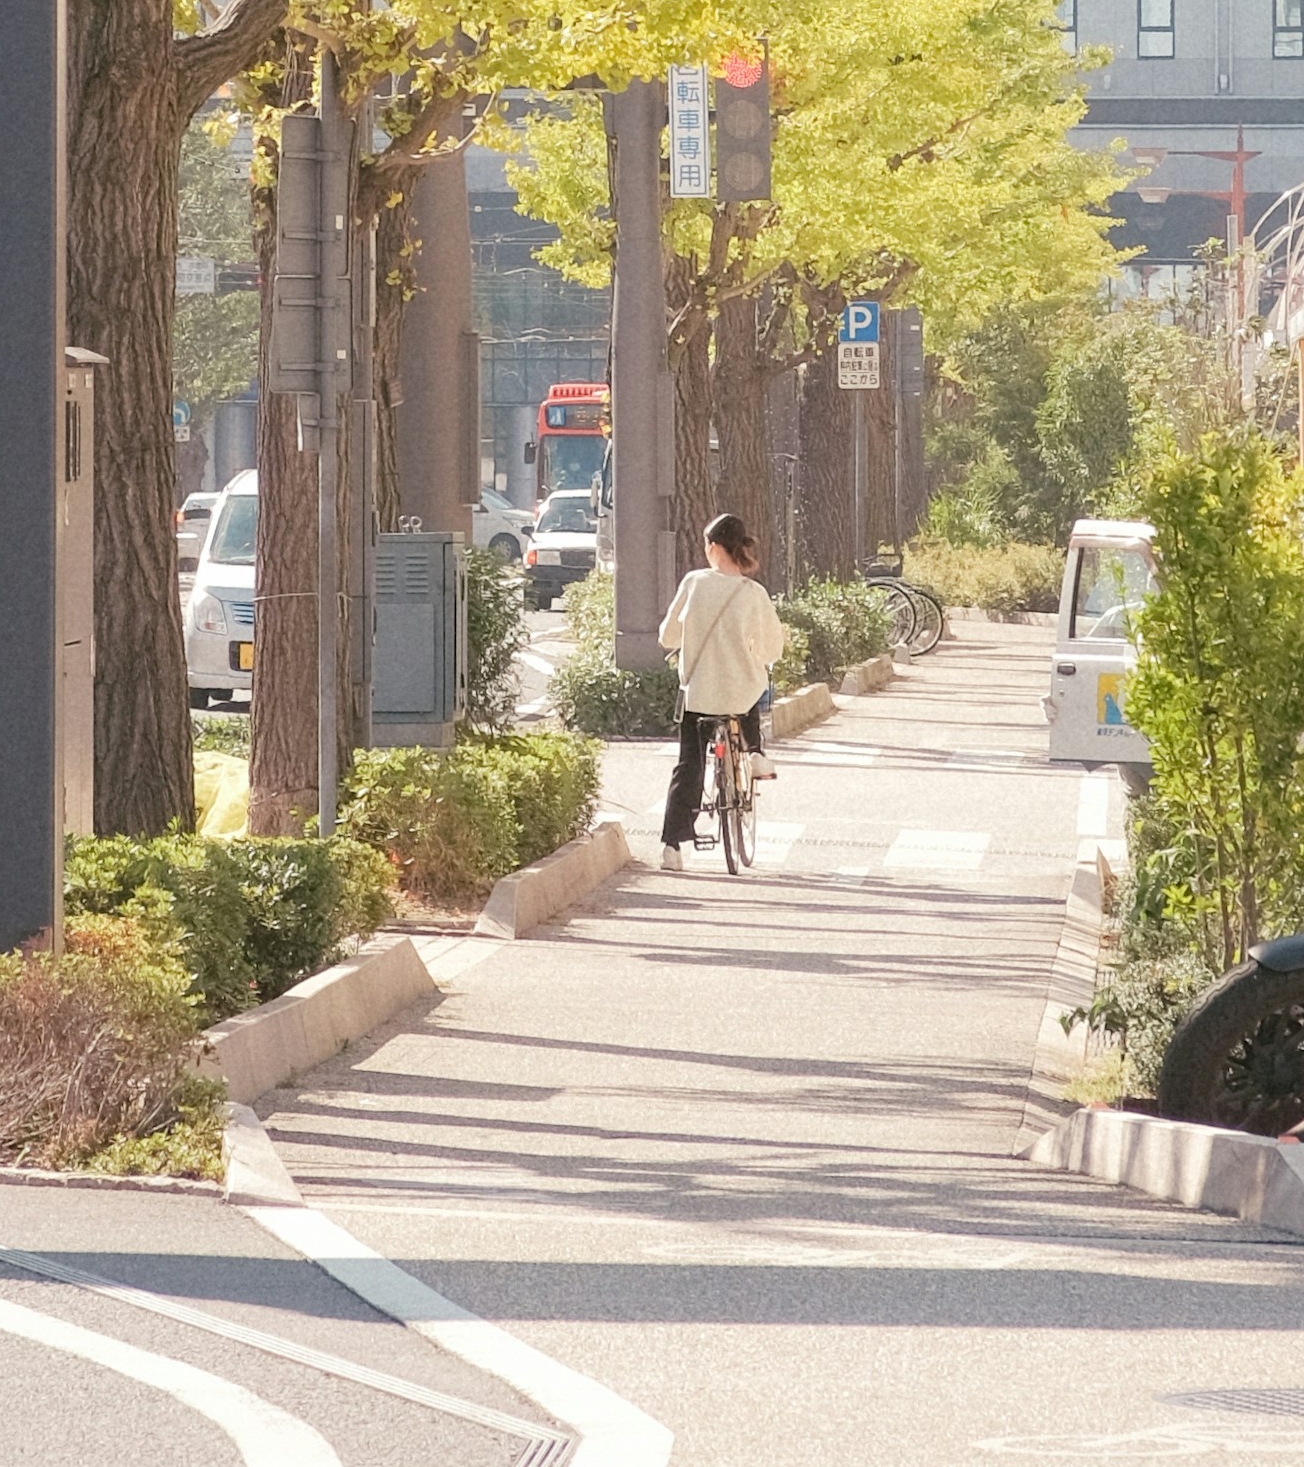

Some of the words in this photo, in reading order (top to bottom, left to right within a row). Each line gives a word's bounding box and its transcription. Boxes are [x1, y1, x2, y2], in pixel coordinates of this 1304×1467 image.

[849, 306, 873, 339] P
[843, 347, 875, 358] 自転車
[840, 374, 878, 385] ここから
